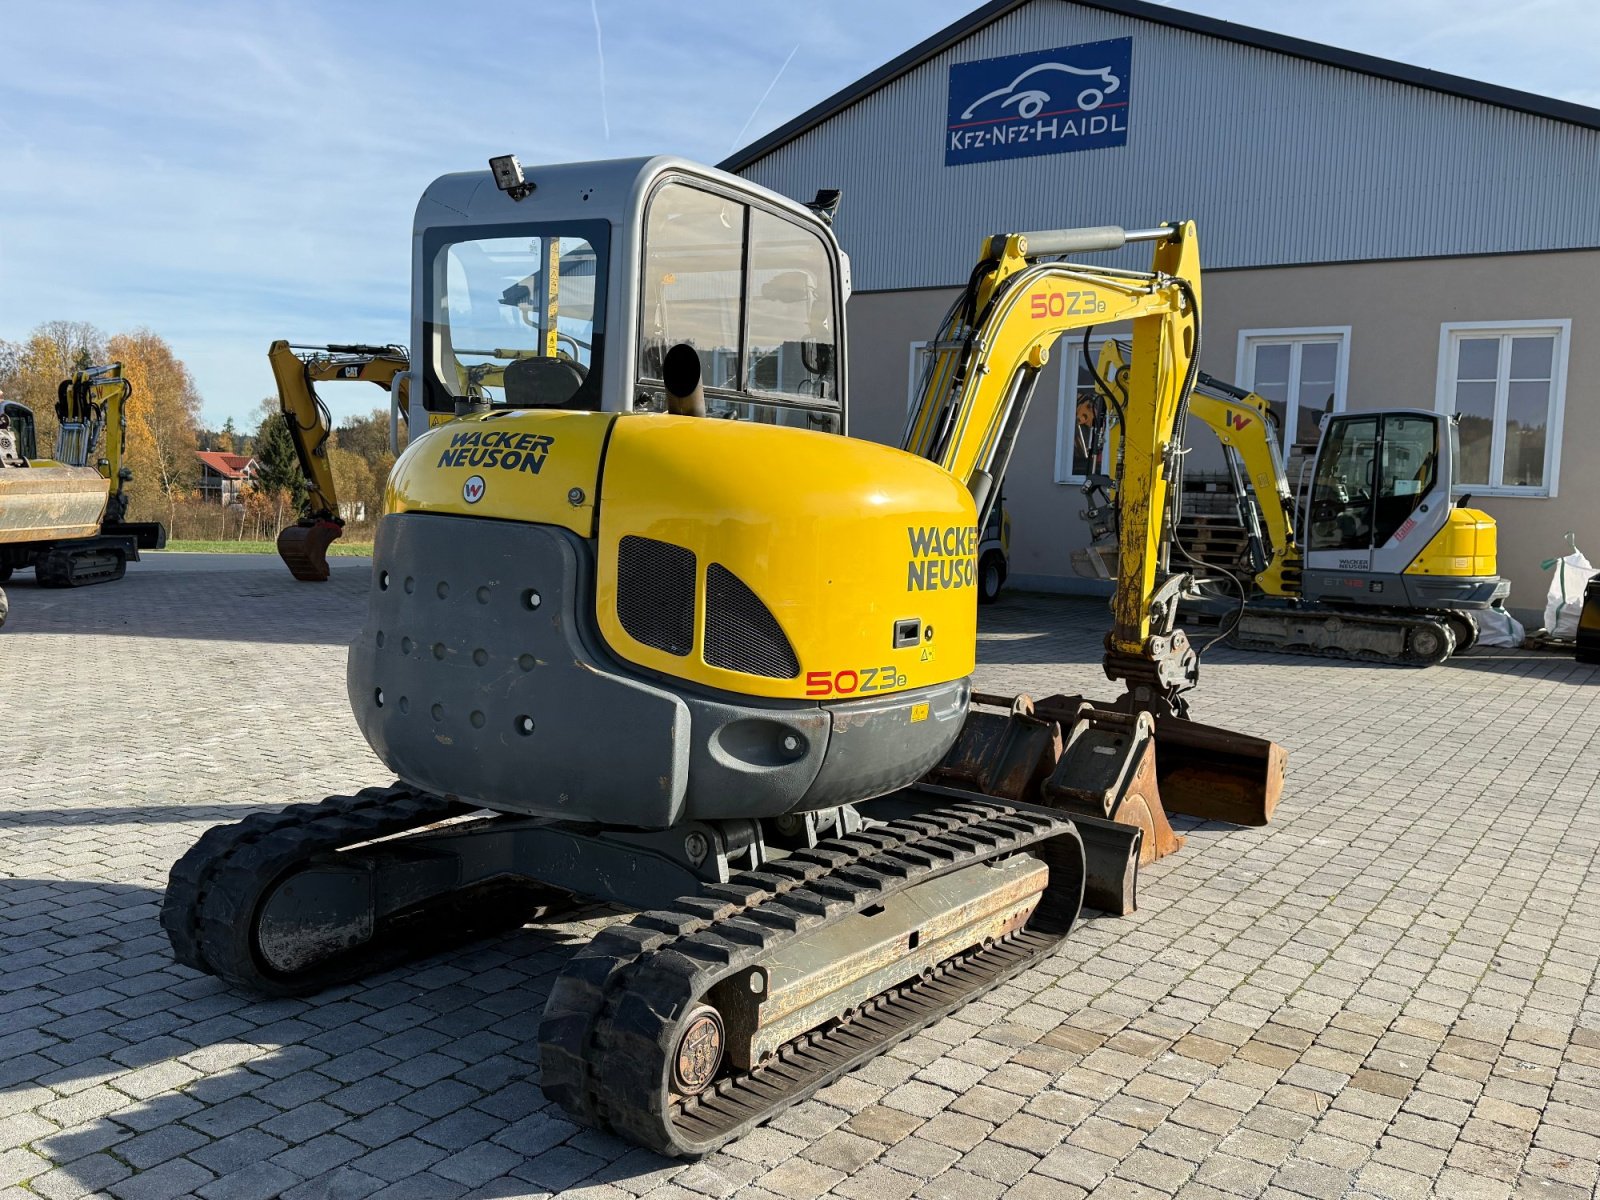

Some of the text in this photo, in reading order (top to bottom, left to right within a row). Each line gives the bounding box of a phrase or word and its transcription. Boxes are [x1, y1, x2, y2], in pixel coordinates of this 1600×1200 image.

[345, 366, 358, 378] CAT
[450, 432, 554, 454] WACKER
[437, 448, 547, 475] NEUSON
